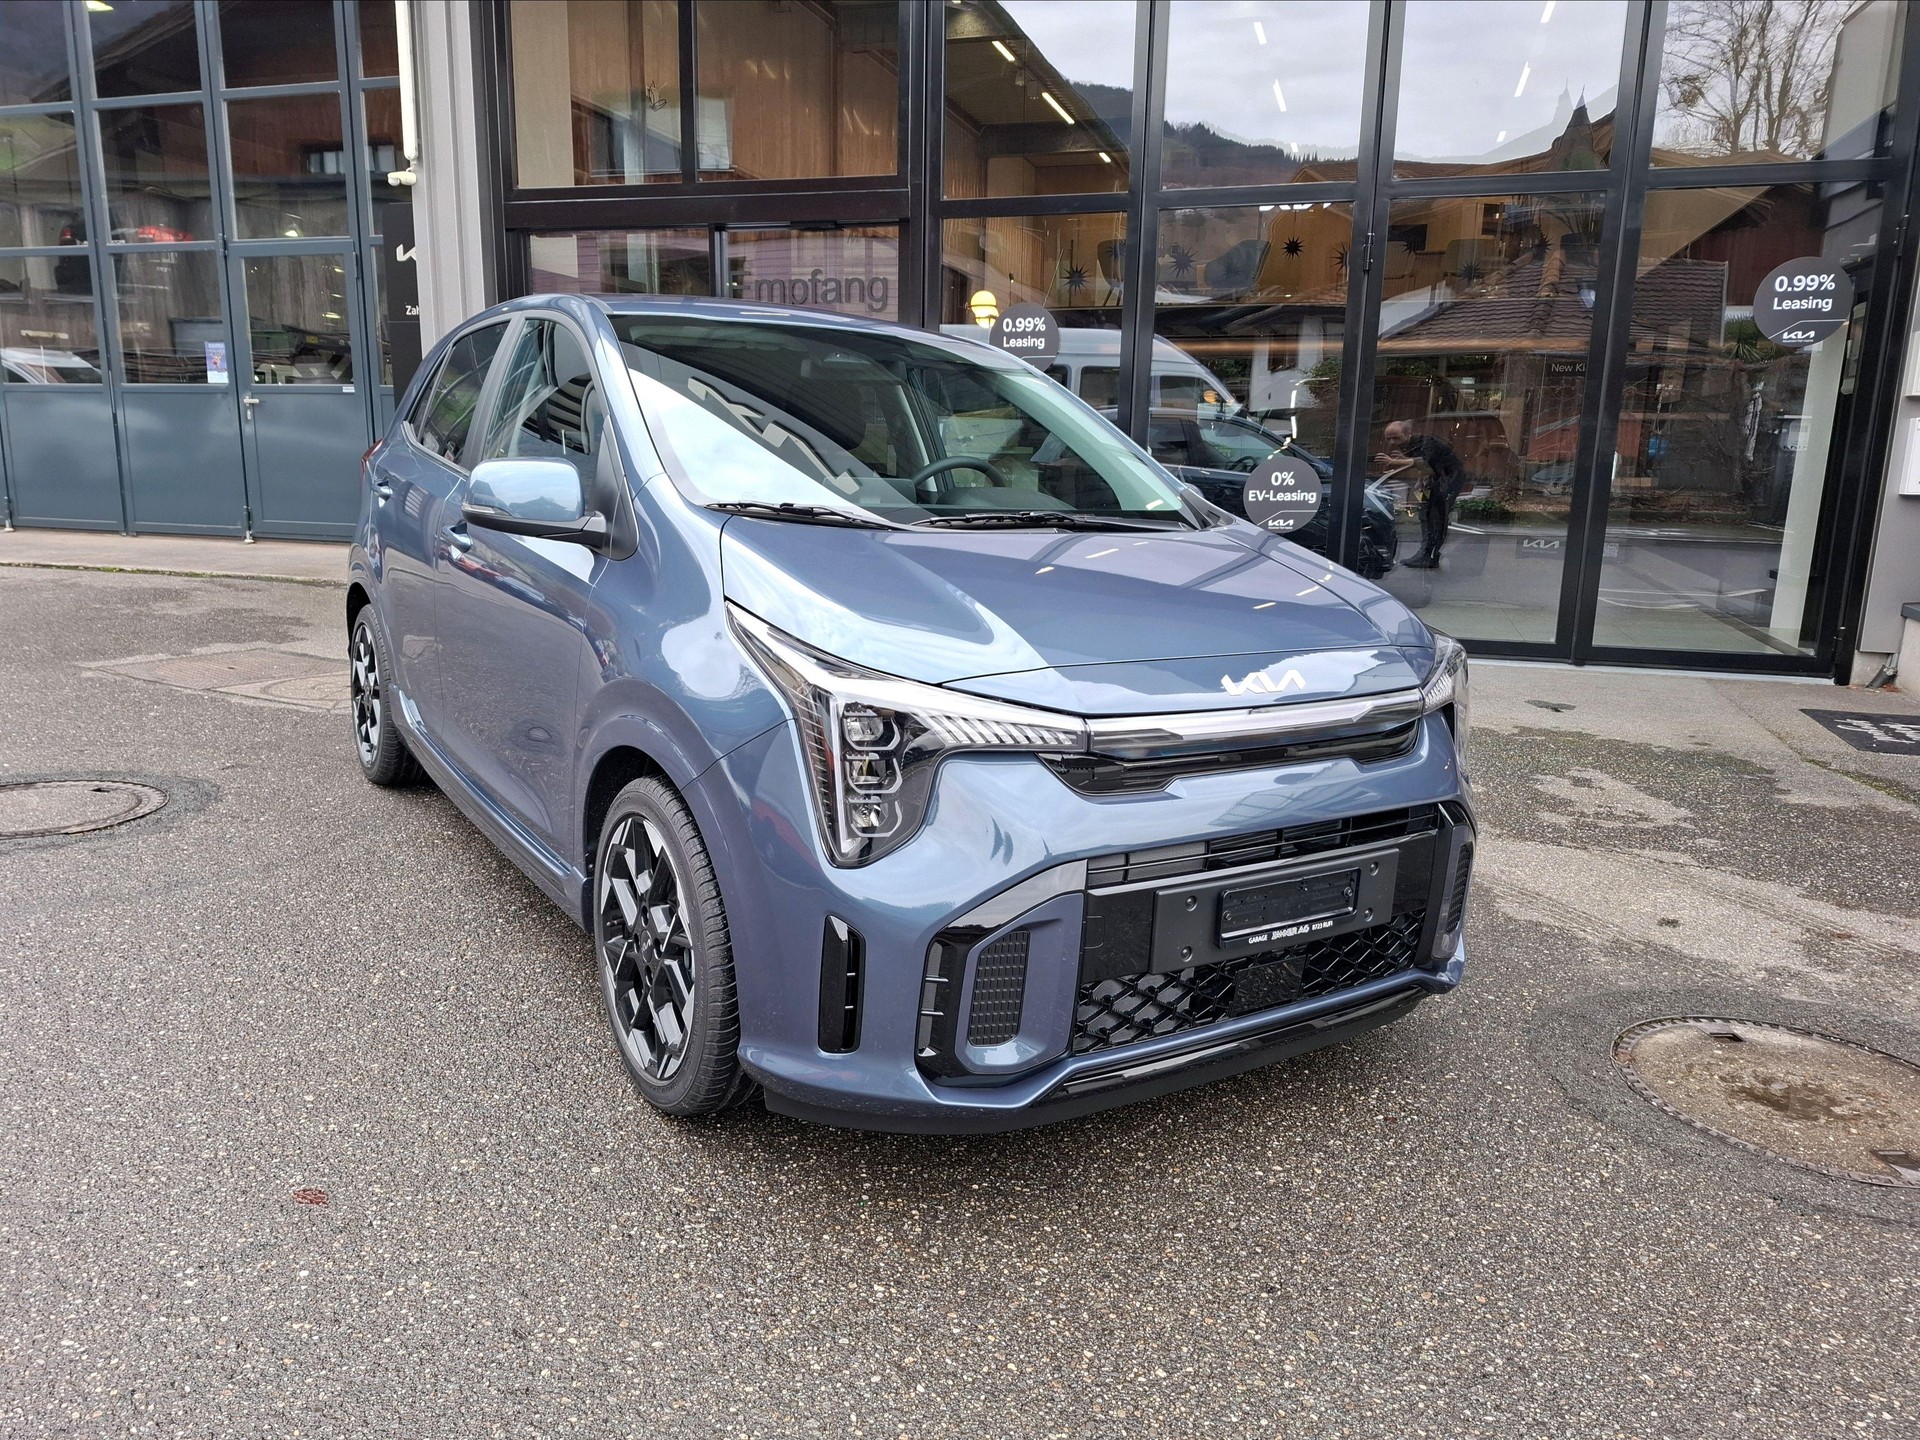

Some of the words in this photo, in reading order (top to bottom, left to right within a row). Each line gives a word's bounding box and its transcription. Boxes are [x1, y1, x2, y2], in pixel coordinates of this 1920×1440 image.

[1775, 274, 1836, 292] 0.99%
[1773, 296, 1833, 312] Leasing
[1002, 316, 1046, 332] 0.99%
[1003, 335, 1045, 350] Leasing
[1551, 363, 1573, 372] New
[1271, 471, 1295, 486] 0%
[1248, 489, 1317, 504] EV-Leasing
[1220, 669, 1306, 696] KIA
[1248, 934, 1268, 944] GARAGE
